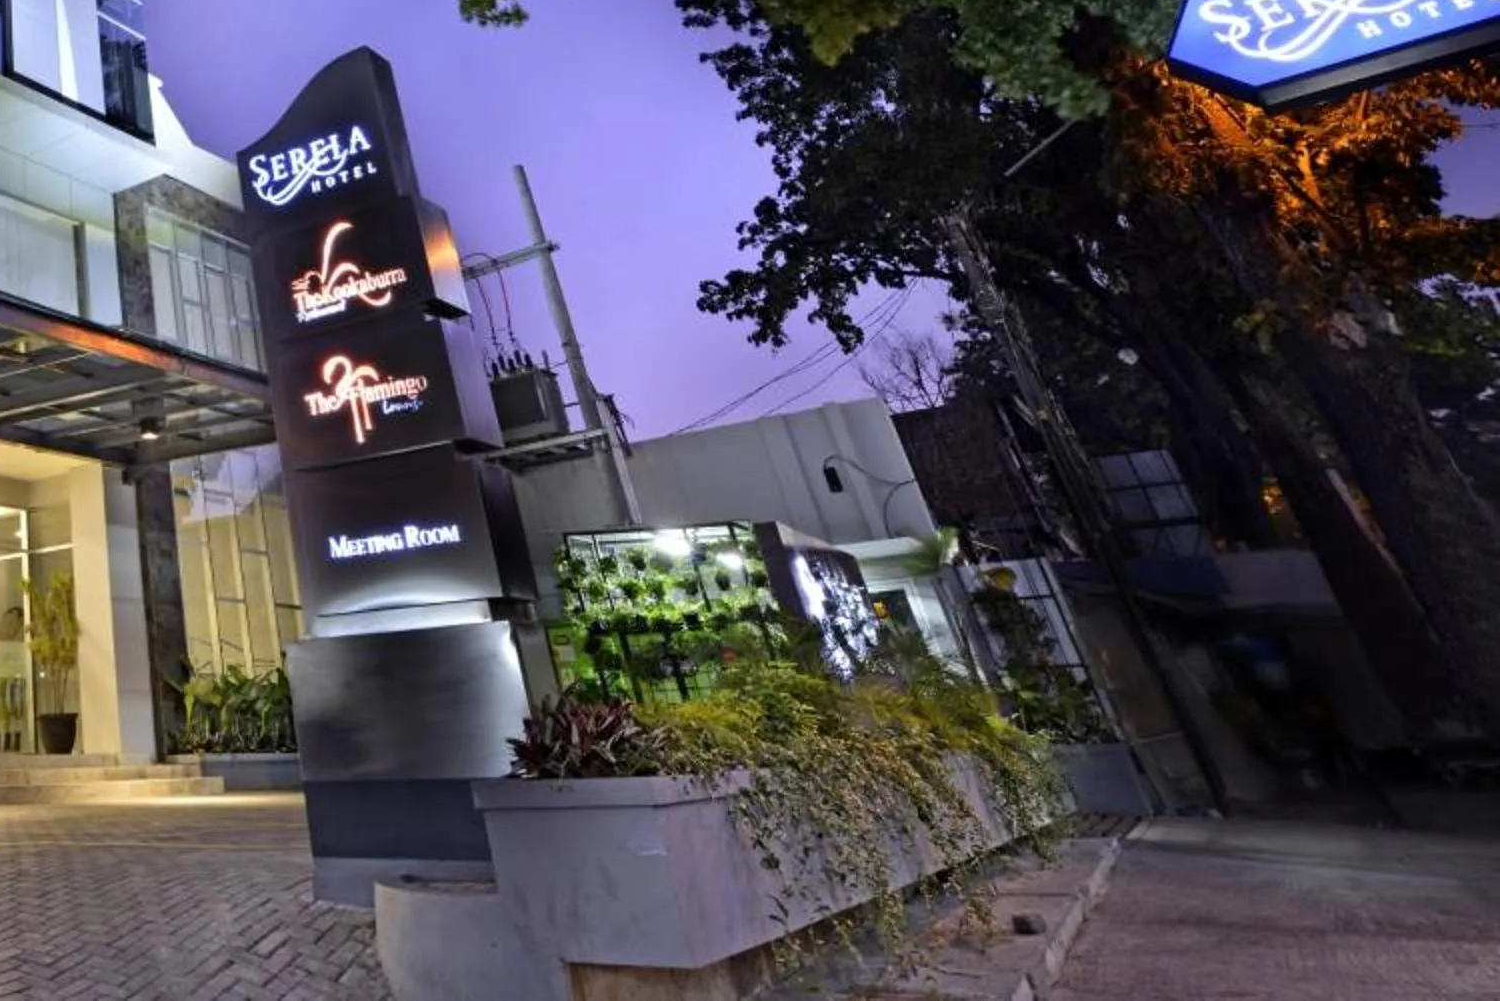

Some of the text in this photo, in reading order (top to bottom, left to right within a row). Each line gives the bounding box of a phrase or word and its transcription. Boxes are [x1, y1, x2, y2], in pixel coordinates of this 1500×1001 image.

[249, 125, 372, 205] SERELA
[311, 161, 377, 194] HOTEL
[303, 391, 337, 416] The
[328, 523, 461, 559] MEETING ROOM
